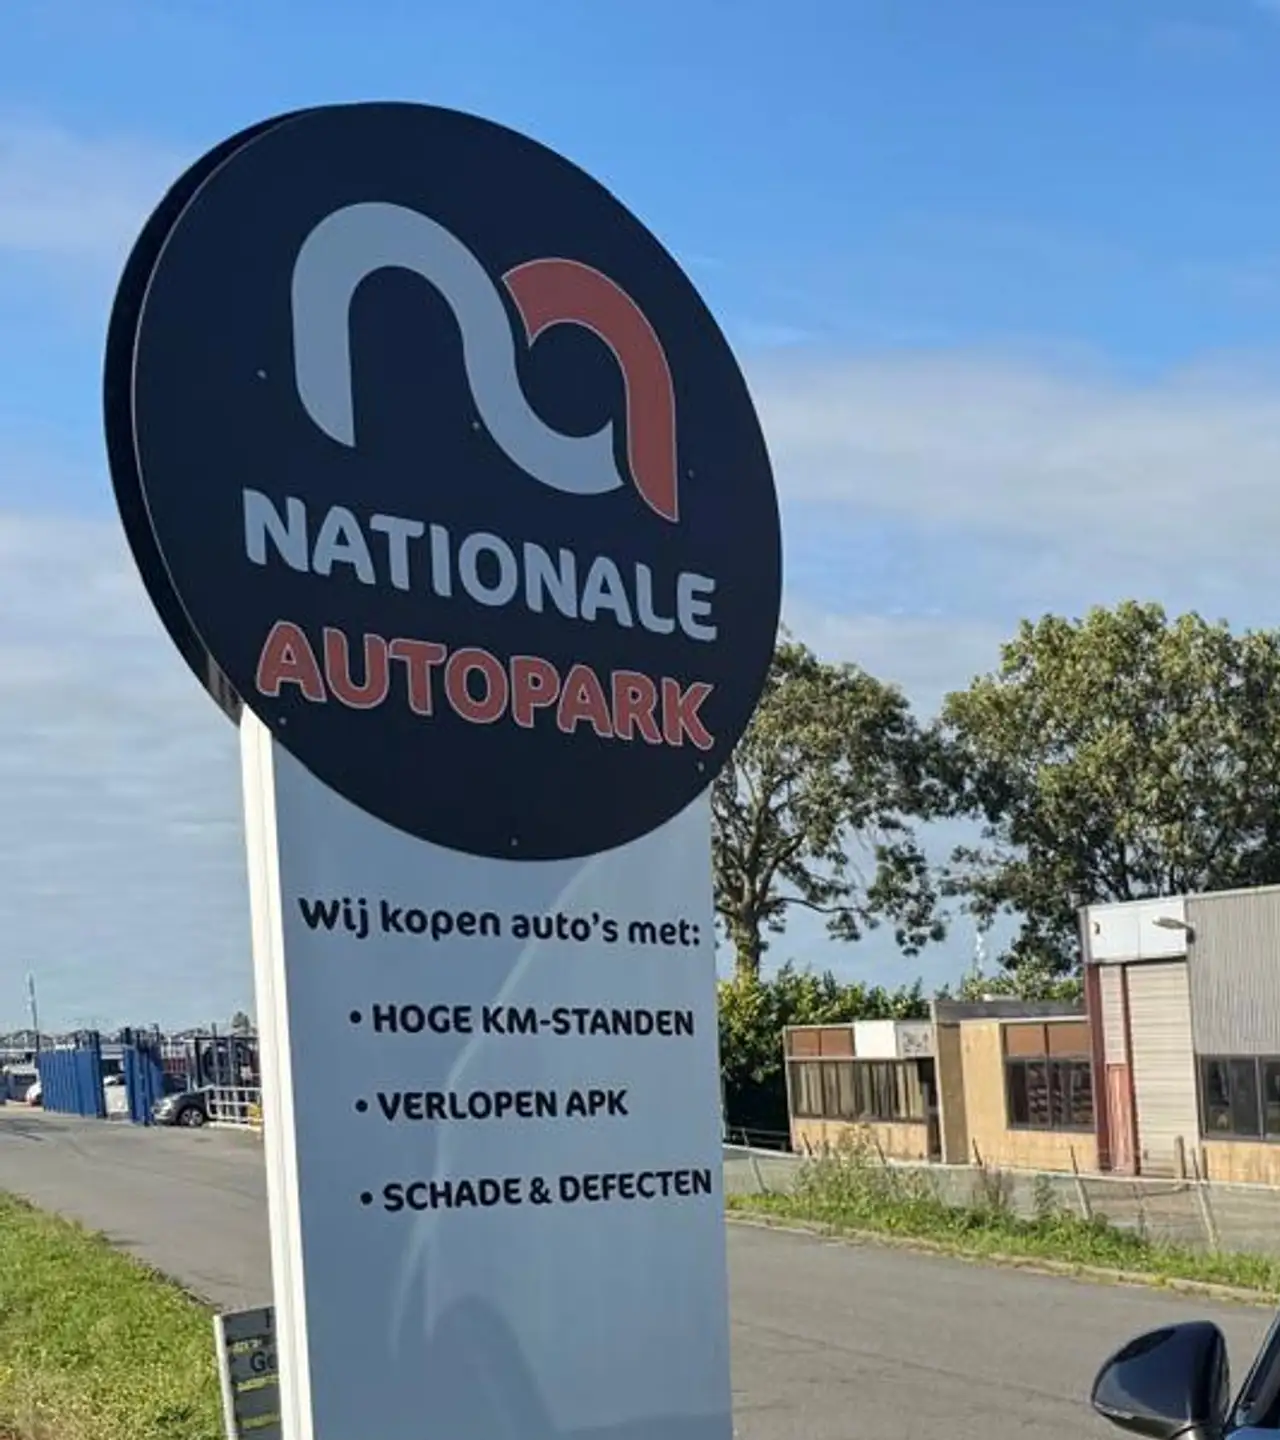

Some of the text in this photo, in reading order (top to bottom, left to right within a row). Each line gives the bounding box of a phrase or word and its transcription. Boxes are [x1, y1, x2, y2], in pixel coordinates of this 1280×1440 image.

[242, 487, 718, 642] NATIONALE
[255, 619, 716, 751] AUTOPARK
[298, 896, 702, 947] Wij kopen auto's met:
[372, 1003, 695, 1037] HOGE KM-STANDEN
[376, 1088, 629, 1122] VERLOPEN APK
[382, 1168, 713, 1213] SCHADE & DEFECTEN
